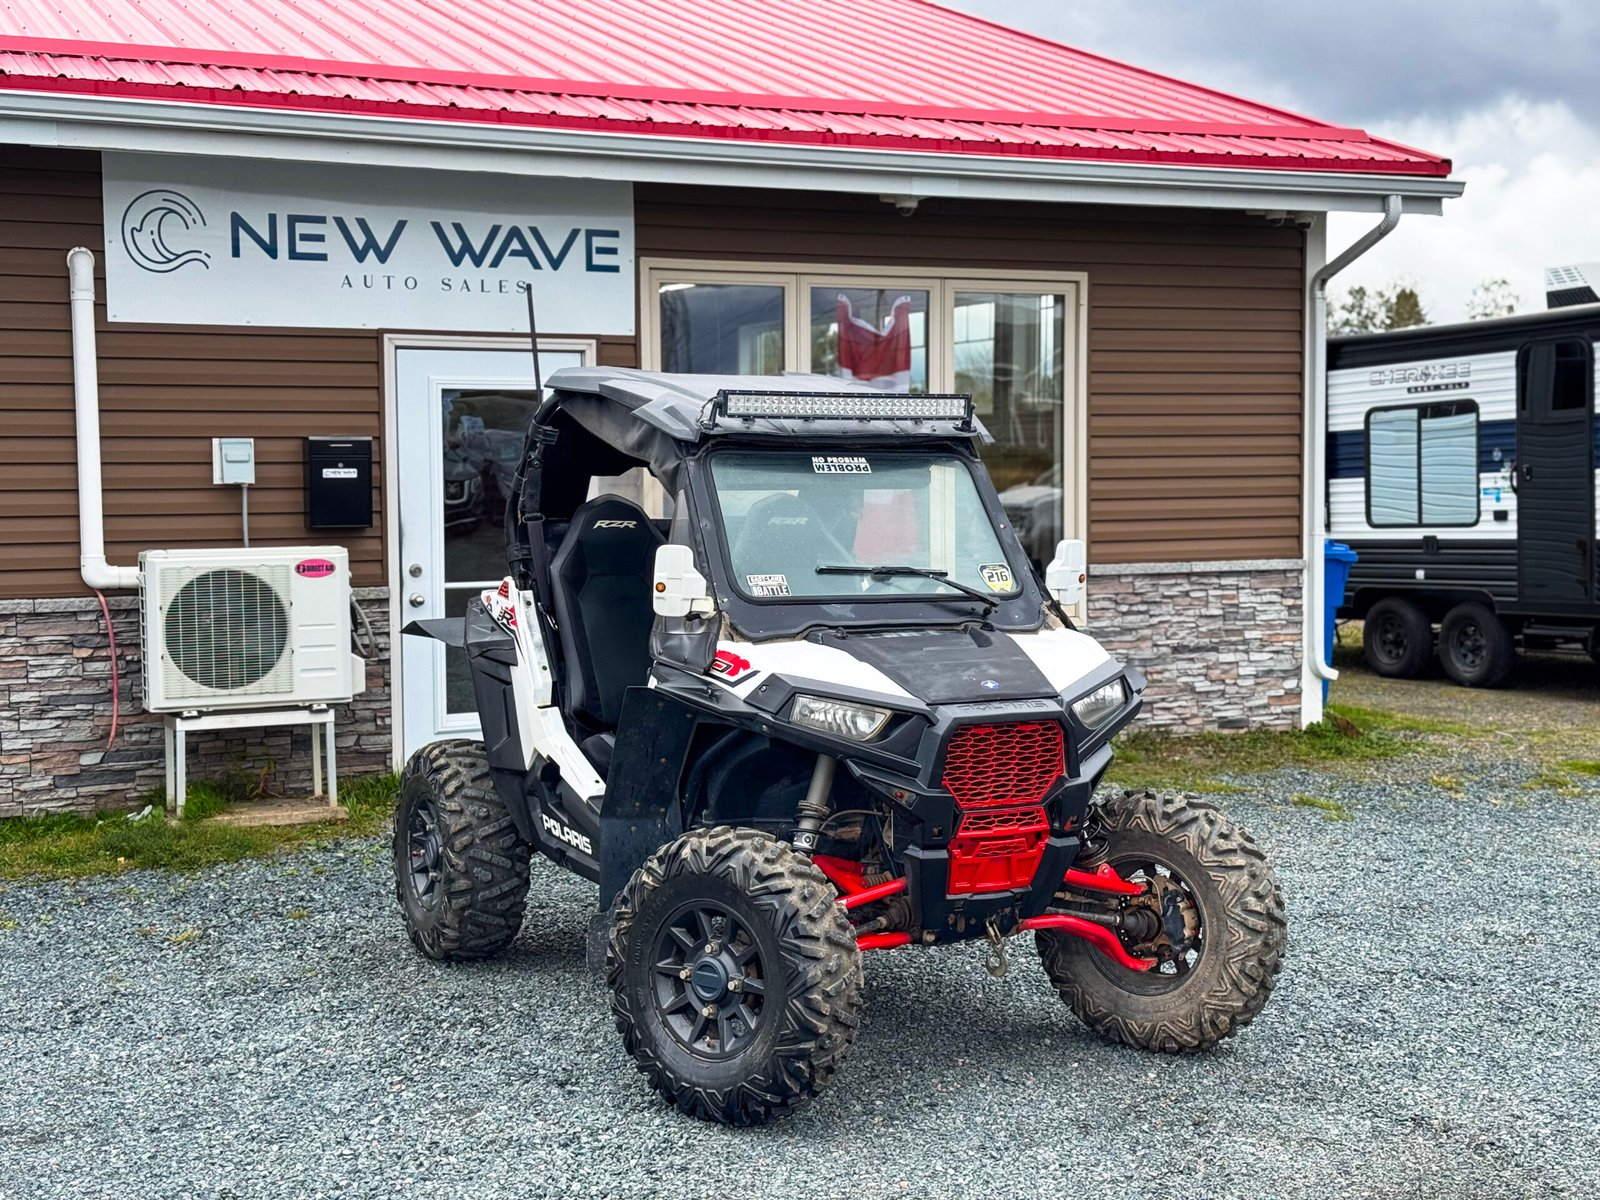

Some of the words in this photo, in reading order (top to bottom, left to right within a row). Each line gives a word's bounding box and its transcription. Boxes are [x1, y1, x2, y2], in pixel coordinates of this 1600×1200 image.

[230, 210, 409, 265] NEW
[429, 221, 621, 273] WAVE
[340, 274, 419, 291] AUTO
[441, 278, 529, 295] SALES
[814, 464, 870, 472] PROBLEM
[592, 520, 638, 530] RZR
[306, 564, 325, 573] DIRECT
[986, 571, 1009, 583] 216
[542, 813, 592, 855] POLARIS
